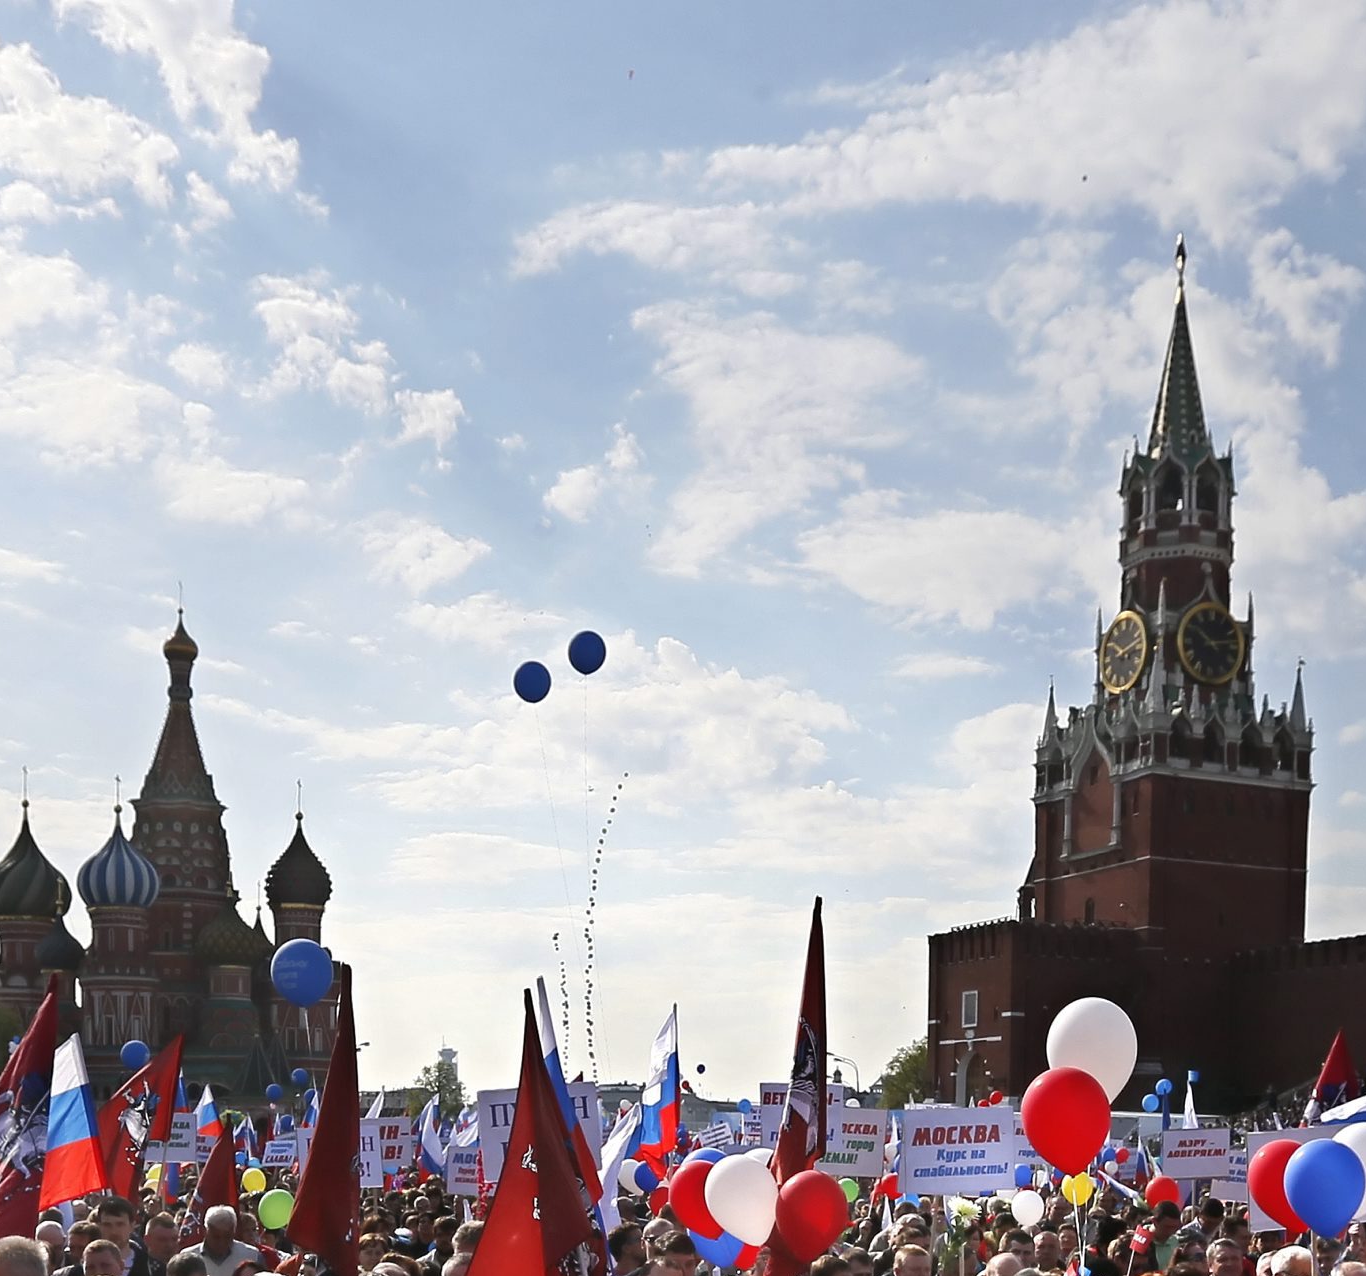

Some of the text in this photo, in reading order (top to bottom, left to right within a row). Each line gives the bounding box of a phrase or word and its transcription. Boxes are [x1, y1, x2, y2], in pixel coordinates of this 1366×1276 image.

[911, 1124, 1001, 1147] МОСКВА
[1177, 1139, 1208, 1148] МЭРУ
[936, 1149, 986, 1163] Курс на
[1167, 1148, 1227, 1159] ДОВЕРЯЕМ!
[913, 1162, 1008, 1178] стабильность!
